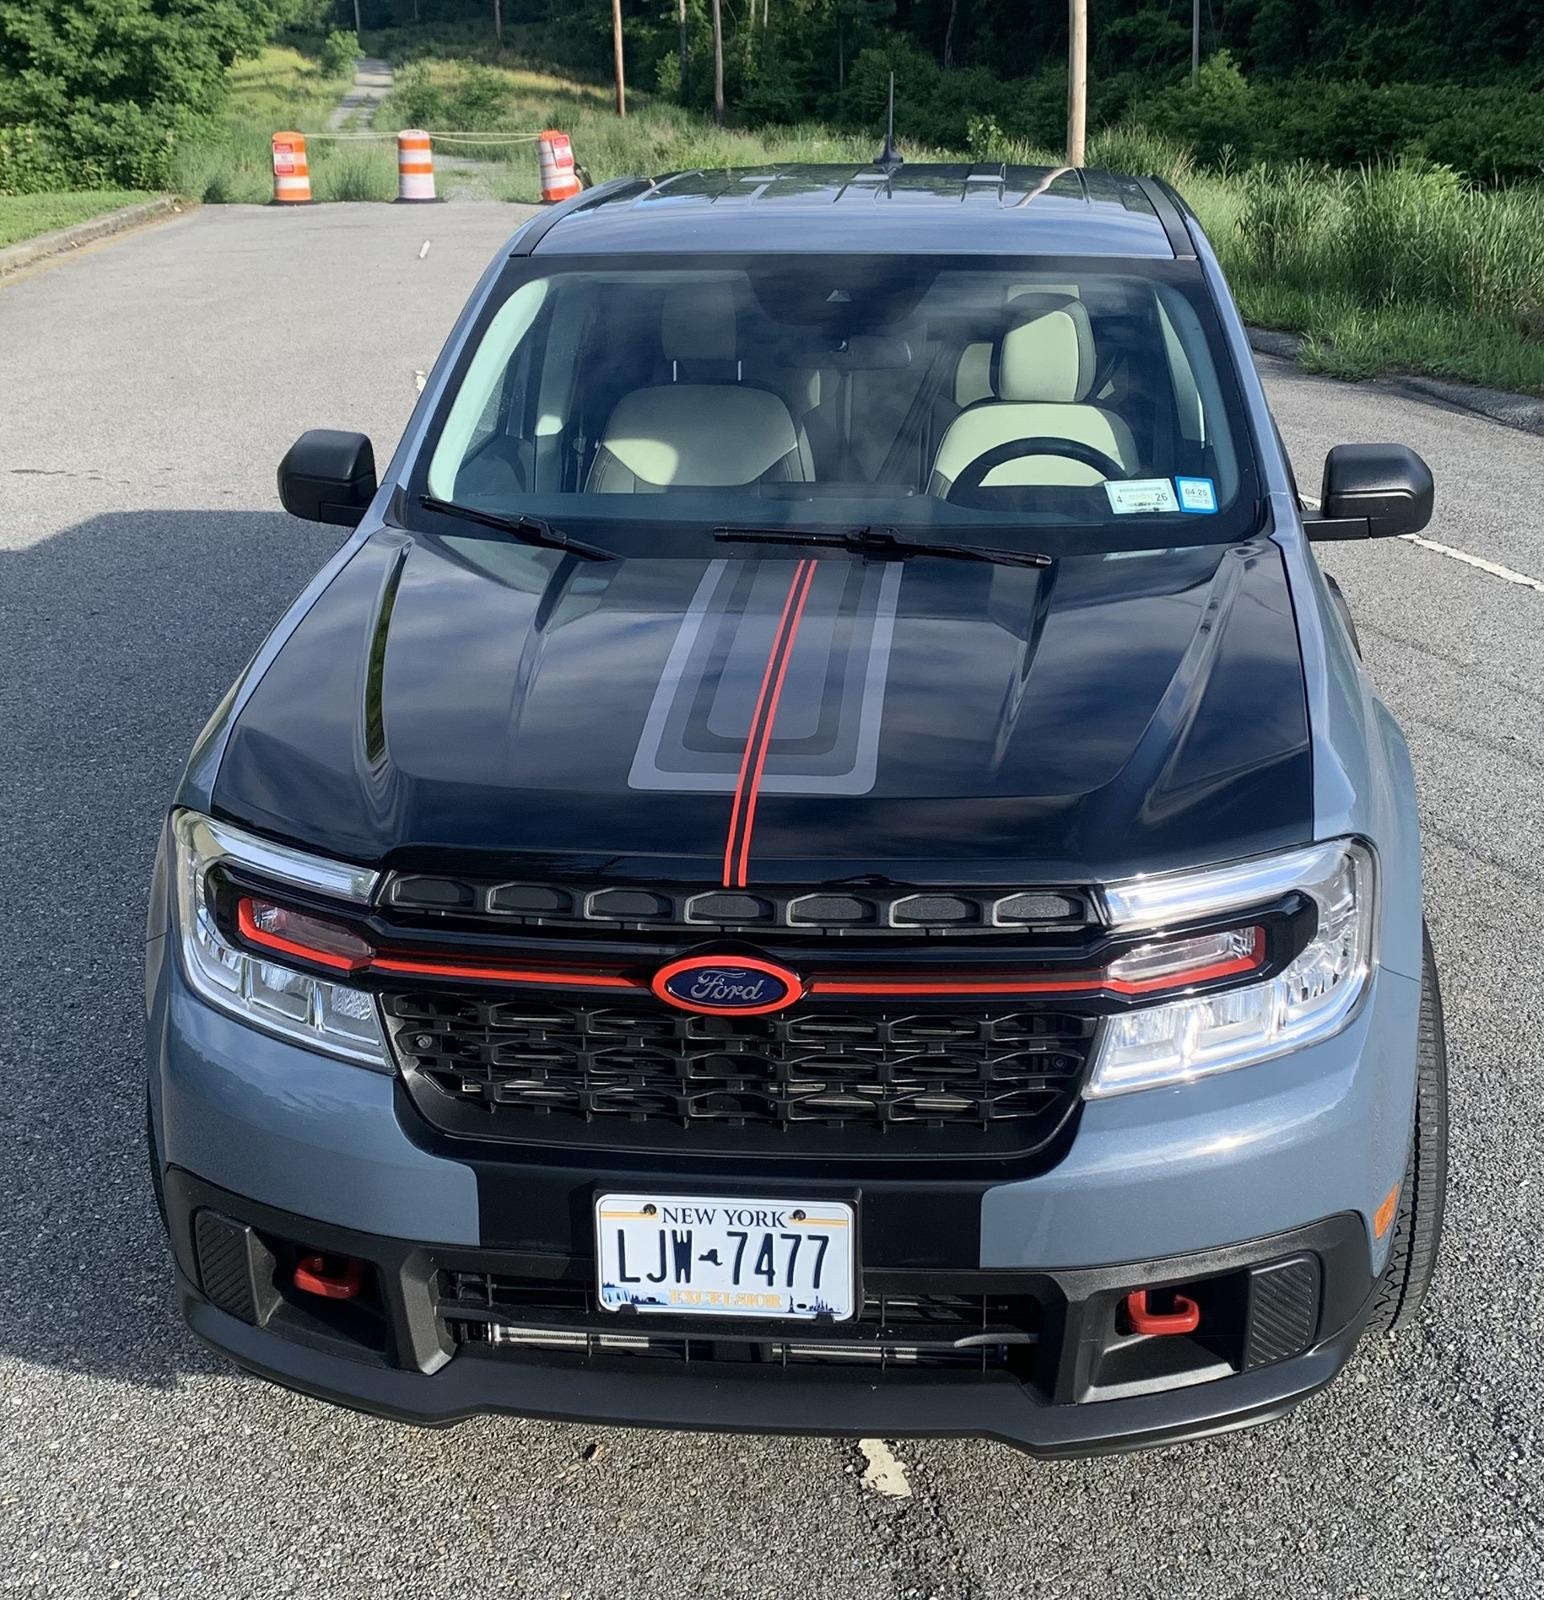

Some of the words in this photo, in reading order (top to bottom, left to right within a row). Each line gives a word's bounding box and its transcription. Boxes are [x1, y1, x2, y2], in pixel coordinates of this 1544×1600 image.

[1155, 492, 1168, 502] 26
[690, 969, 765, 1000] Ford
[662, 1206, 718, 1226] NEW
[722, 1208, 788, 1229] YORK
[617, 1228, 693, 1284] LJW
[726, 1230, 829, 1289] 7477
